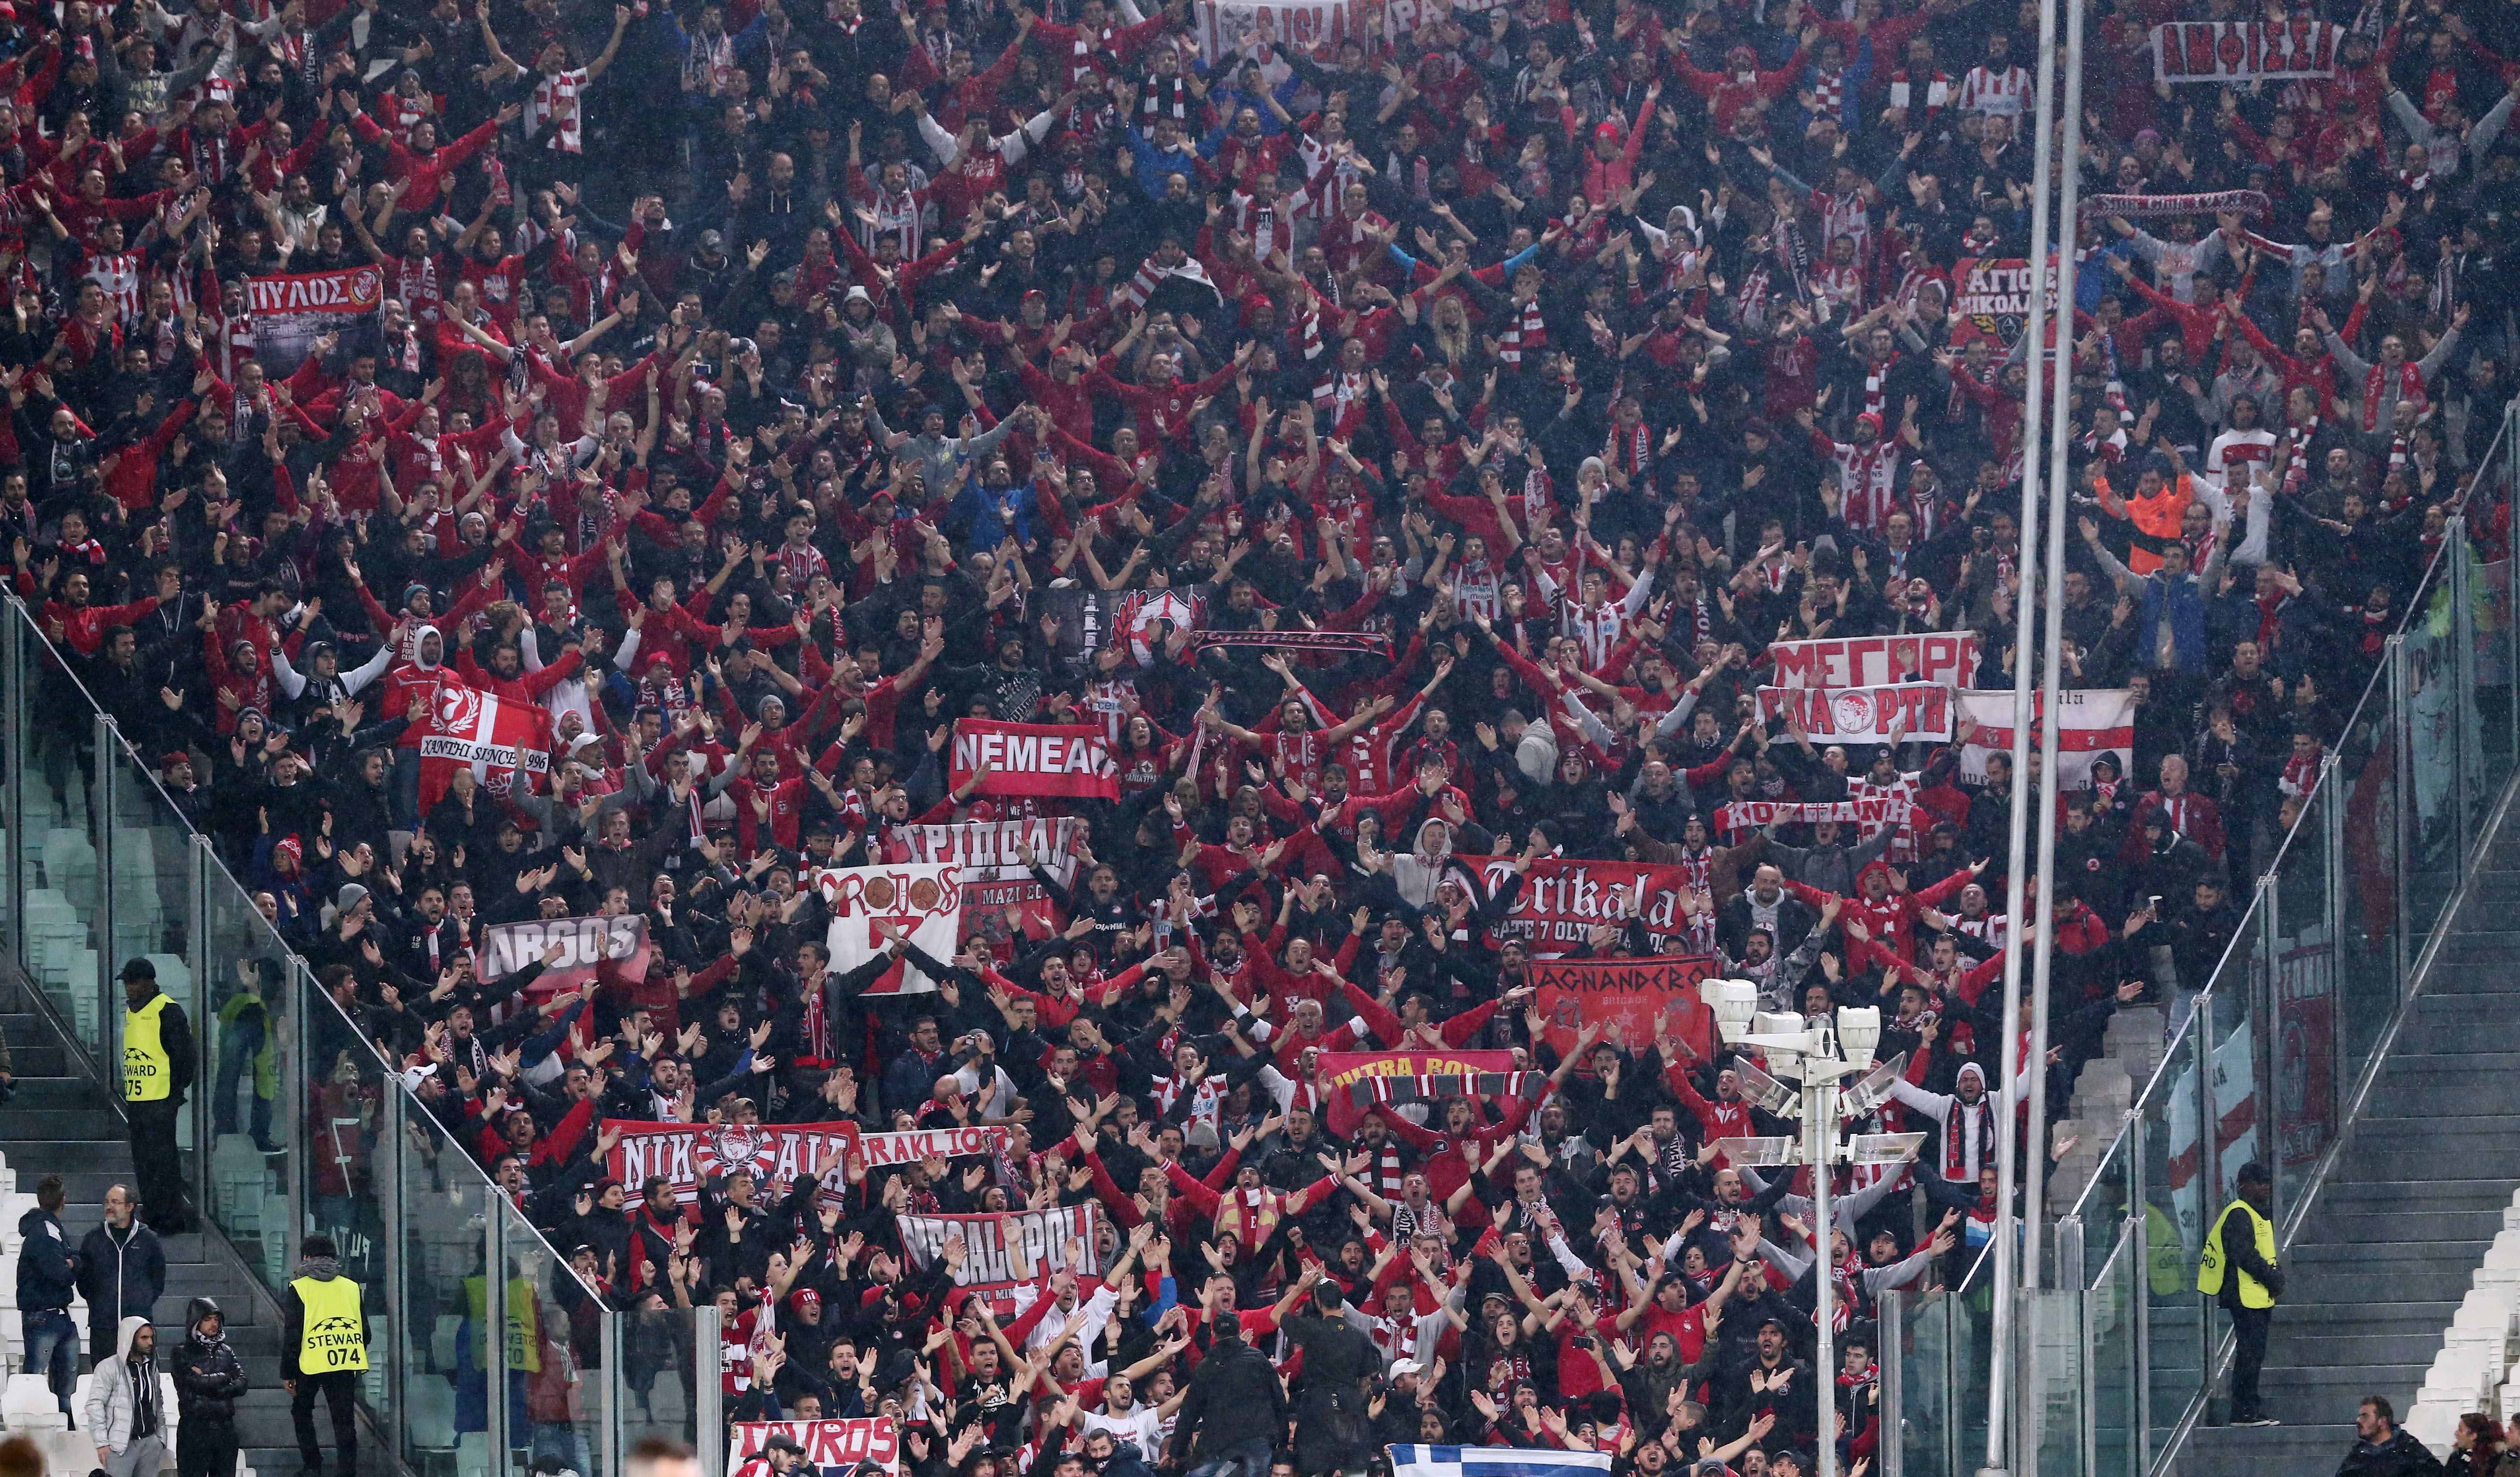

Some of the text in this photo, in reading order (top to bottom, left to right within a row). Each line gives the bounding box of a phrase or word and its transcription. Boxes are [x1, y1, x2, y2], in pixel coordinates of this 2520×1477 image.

[248, 276, 349, 310] ΠΥΛΟΣ
[422, 739, 547, 769] XANTHI SINCE 996
[1540, 921, 1550, 940] 7
[487, 916, 637, 977] ARGOS
[1602, 995, 1648, 1005] BRIGADE
[327, 1349, 360, 1366] 074
